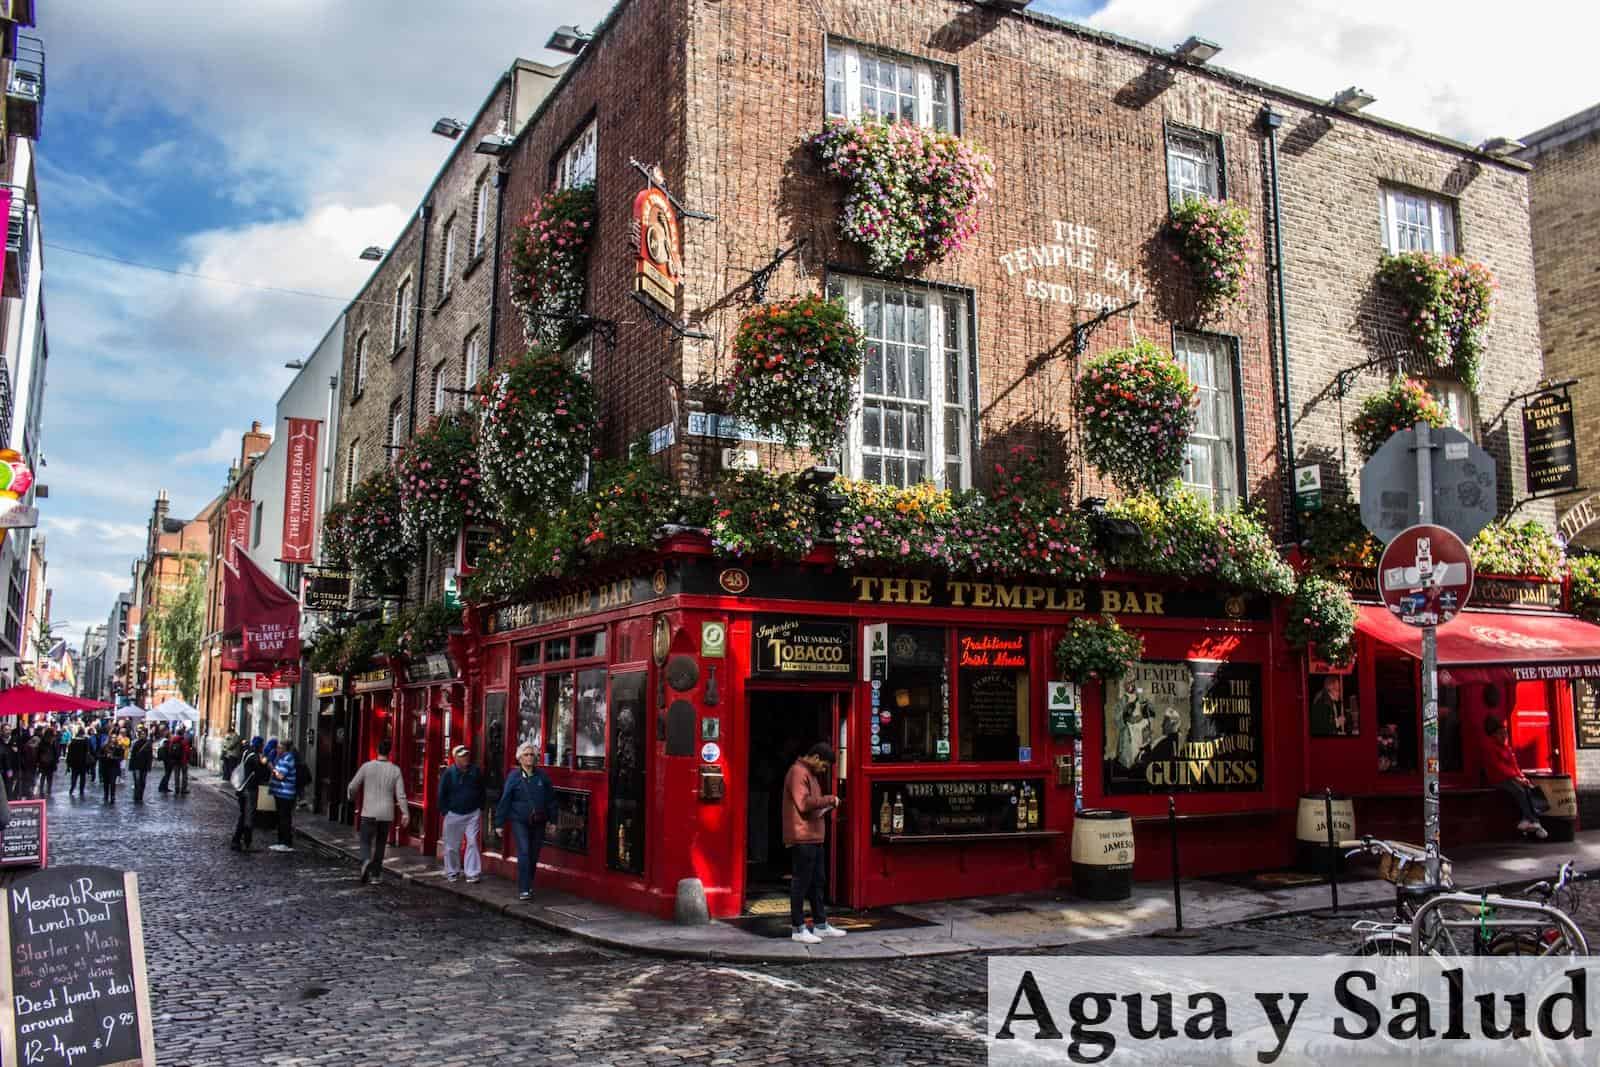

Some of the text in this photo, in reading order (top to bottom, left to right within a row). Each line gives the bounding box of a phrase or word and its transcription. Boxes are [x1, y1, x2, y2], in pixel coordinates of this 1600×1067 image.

[1053, 219, 1097, 248] THE
[1000, 245, 1146, 302] TEMPLE BAR
[1539, 397, 1553, 406] THE
[1525, 402, 1570, 420] TEMPLE
[1535, 416, 1560, 430] BAR
[1545, 439, 1571, 449] GARDEN
[1530, 469, 1547, 478] LIVE
[1548, 464, 1572, 475] MUSIC
[1541, 474, 1563, 484] DAILY
[289, 444, 304, 538] THE TEMPLE BAR
[302, 480, 311, 523] TRADING
[1560, 499, 1596, 537] THE
[537, 590, 592, 621] TEMPLE
[599, 579, 633, 608] BAR
[853, 576, 1165, 615] THE TEMPLE BAR
[247, 630, 296, 642] TEMPLE
[961, 636, 1024, 650] Traditional
[260, 640, 284, 650] BAR
[768, 639, 843, 667] TOBACCO
[960, 650, 1025, 666] Irish Music
[1137, 668, 1189, 681] TEMPLE
[1513, 667, 1537, 680] THE
[1538, 665, 1582, 679] TEMPLE
[1151, 681, 1176, 695] BAR
[1145, 760, 1257, 785] GUINNESS
[906, 784, 933, 796] THE
[936, 783, 987, 795] TEMPLE
[12, 886, 69, 913] Mexico
[28, 903, 111, 935] Lunch Deal
[16, 938, 68, 962] Starter
[84, 930, 120, 952] Main
[88, 967, 114, 978] drink
[15, 974, 135, 1015] Best lunch deal
[20, 1007, 75, 1034] around
